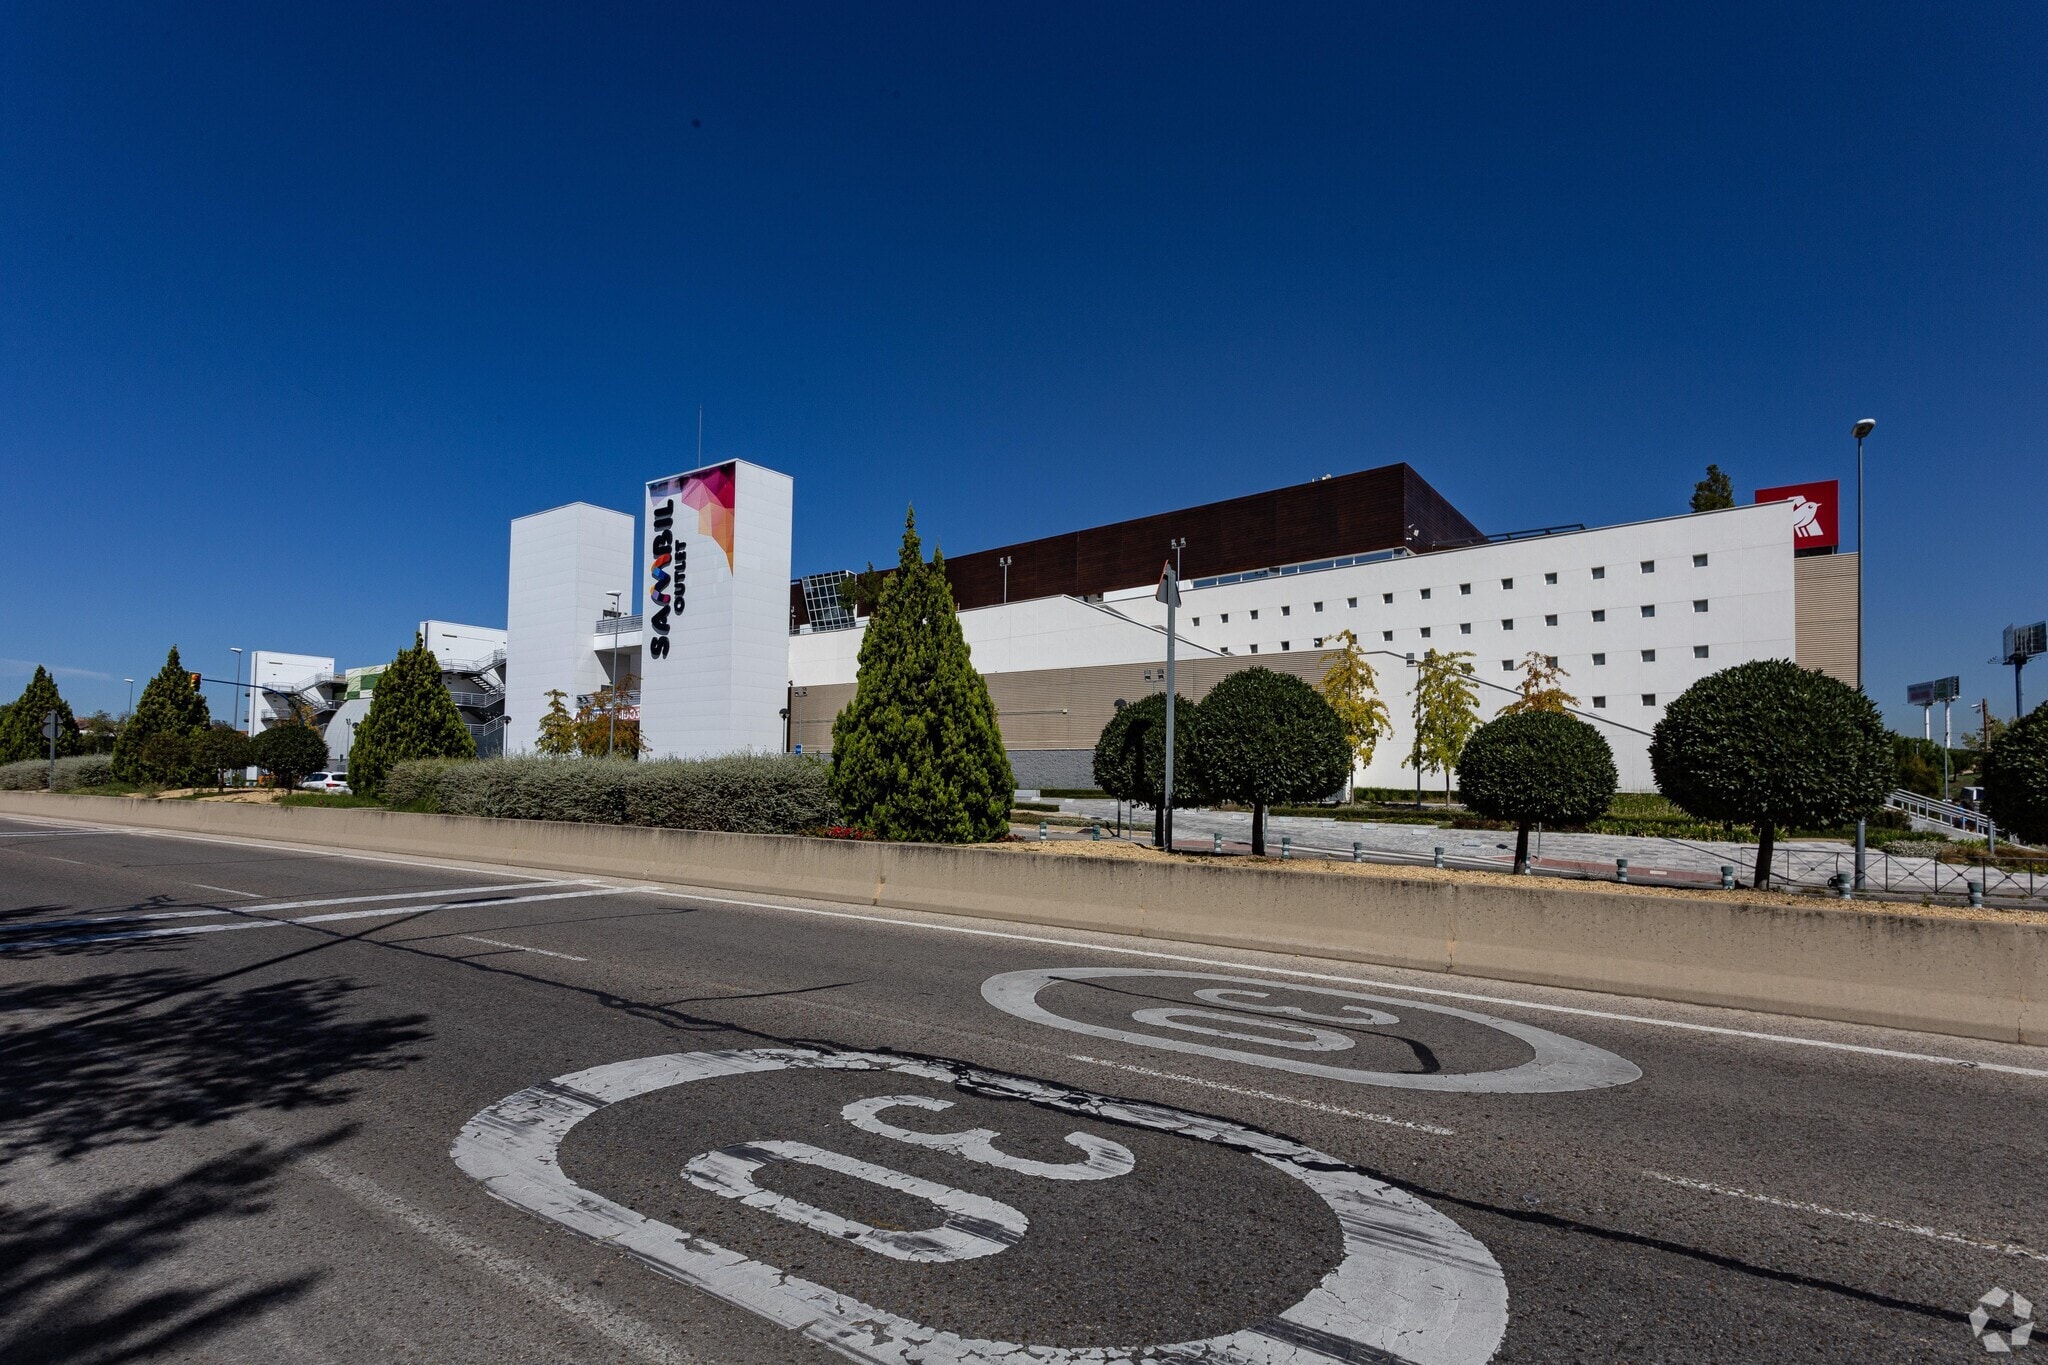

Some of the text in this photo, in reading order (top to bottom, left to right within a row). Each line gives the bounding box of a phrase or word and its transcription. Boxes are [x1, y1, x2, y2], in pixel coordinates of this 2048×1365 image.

[650, 498, 674, 660] SAMBIL
[674, 539, 687, 615] OUTLET
[681, 1095, 1135, 1262] 30
